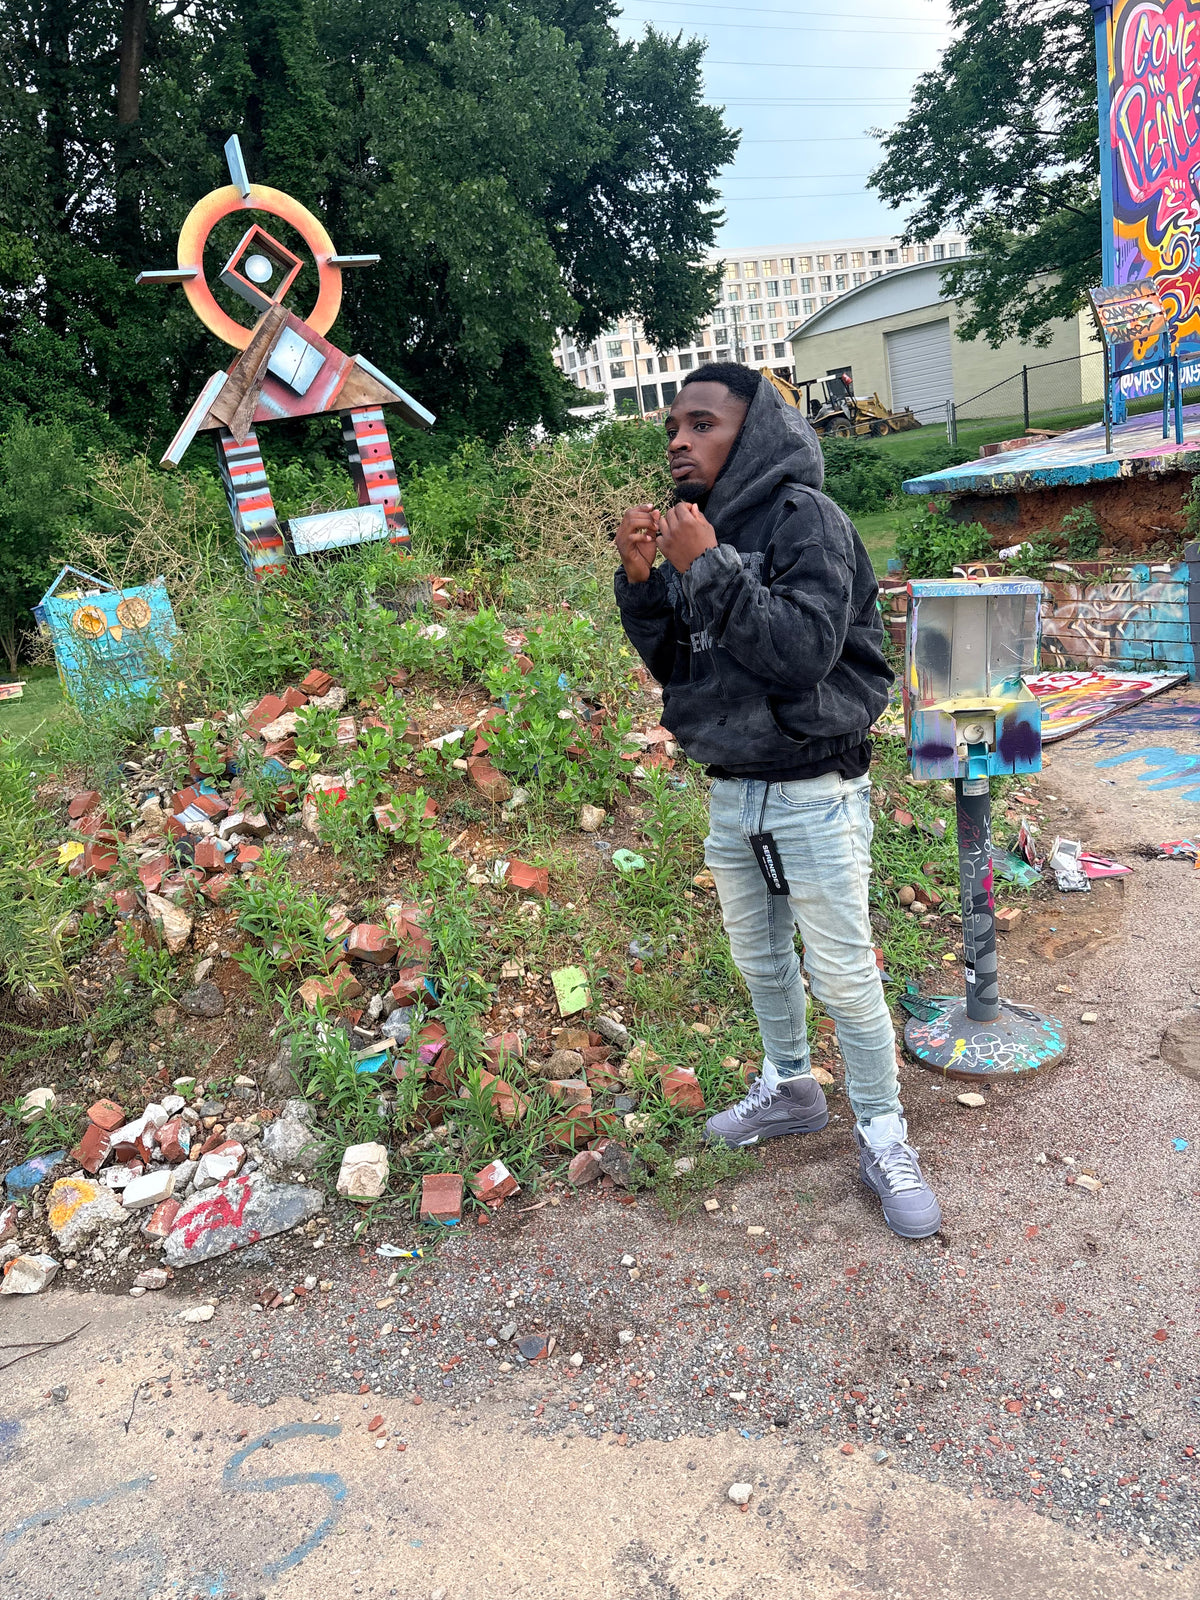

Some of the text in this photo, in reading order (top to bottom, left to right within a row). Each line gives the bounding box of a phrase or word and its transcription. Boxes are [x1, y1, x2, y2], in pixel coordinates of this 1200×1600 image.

[1134, 11, 1198, 78] COME
[1147, 72, 1166, 98] IN
[1117, 73, 1200, 187] PEACE
